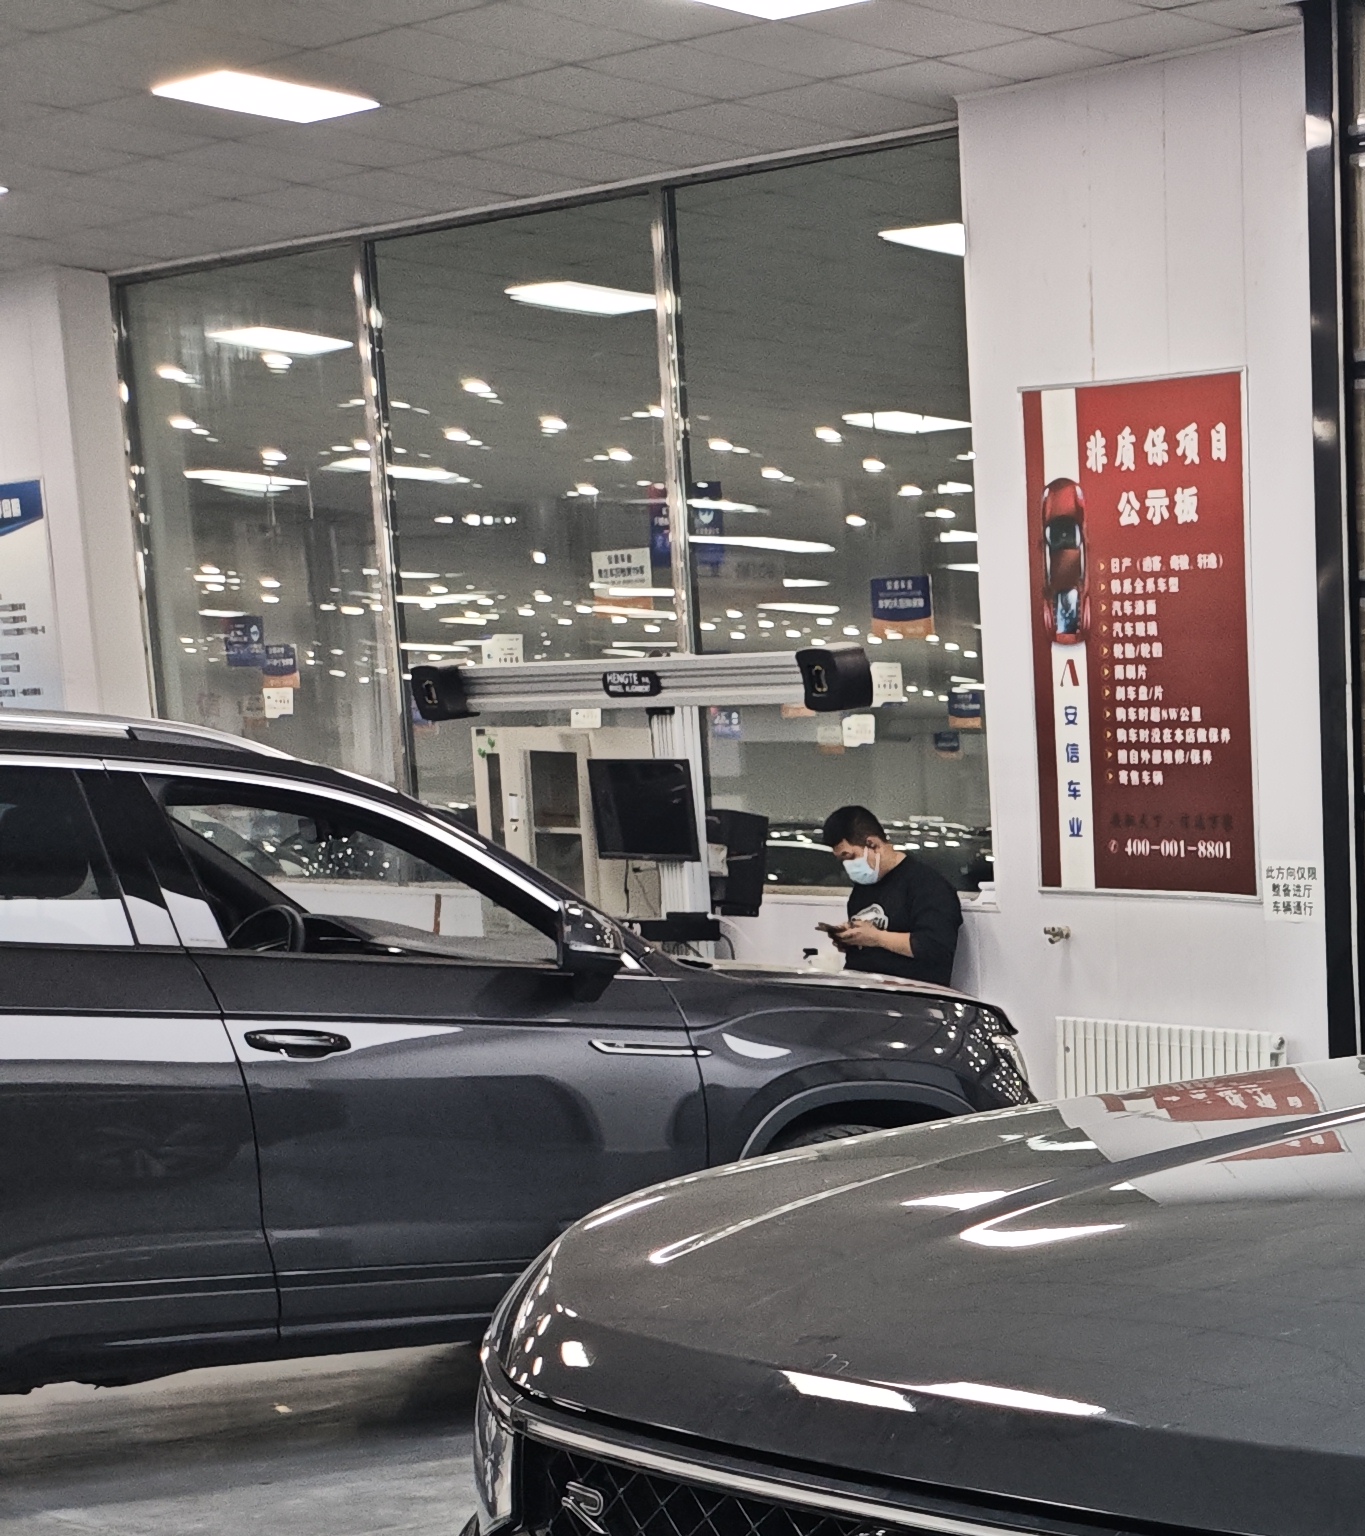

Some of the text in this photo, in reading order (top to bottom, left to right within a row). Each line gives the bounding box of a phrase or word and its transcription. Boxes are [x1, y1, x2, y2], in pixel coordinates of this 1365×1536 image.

[1086, 422, 1227, 473] 非质保项目
[1117, 486, 1199, 526] 公示板
[1125, 838, 1232, 859] 400-001-8801
[1265, 866, 1318, 880] 此方向仅限
